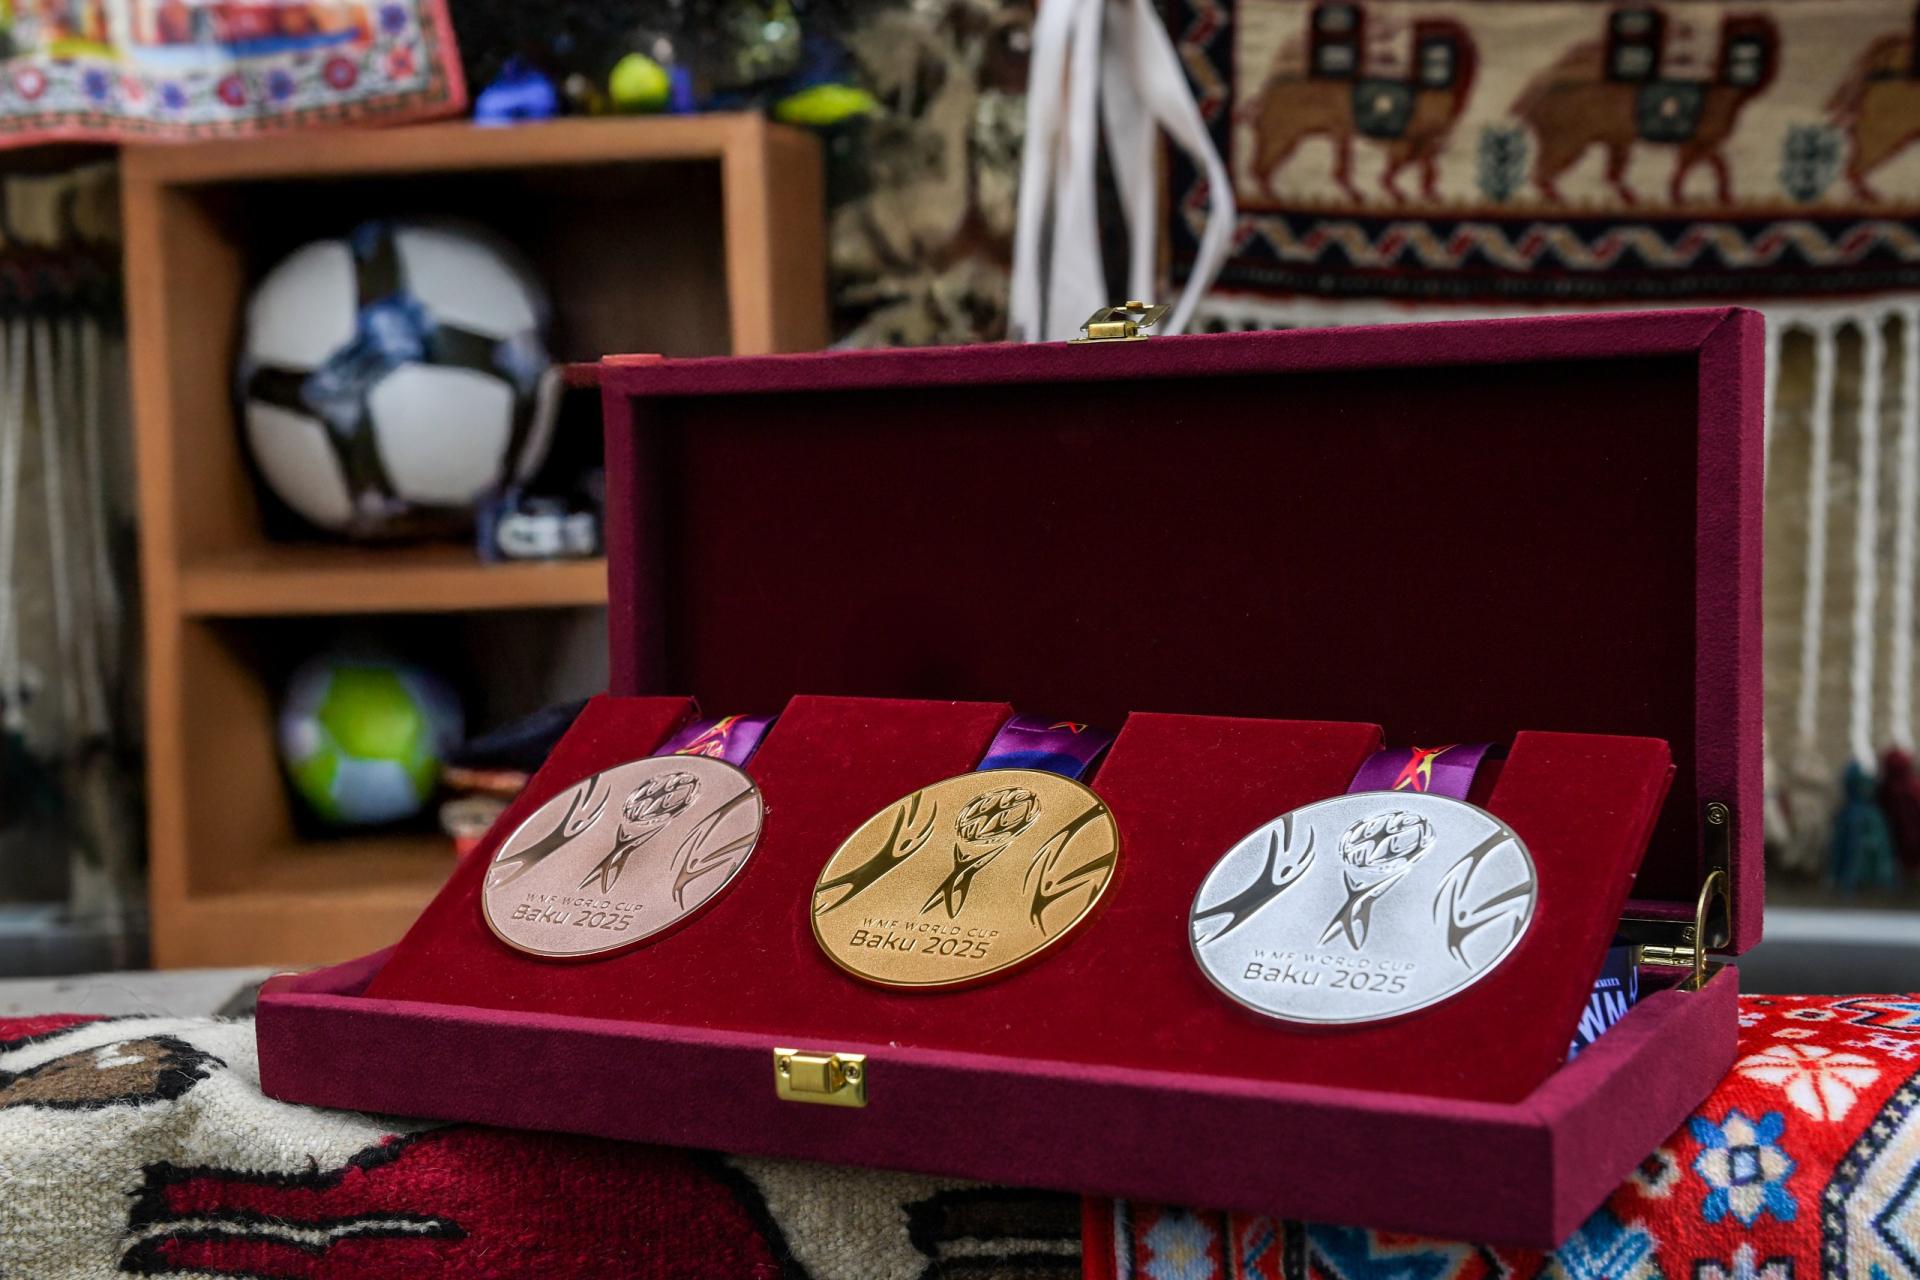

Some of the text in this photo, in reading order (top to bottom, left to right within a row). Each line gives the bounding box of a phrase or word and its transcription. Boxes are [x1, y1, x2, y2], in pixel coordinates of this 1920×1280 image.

[562, 896, 611, 909] WORLD
[615, 902, 644, 912] CUP
[511, 903, 634, 931] Baku 2025
[863, 918, 999, 939] WMF WORLD CUP
[850, 929, 990, 960] Baku 2025
[1304, 953, 1371, 969] WORLD
[1378, 960, 1416, 972] CUP
[1243, 962, 1408, 994] Baku 2025
